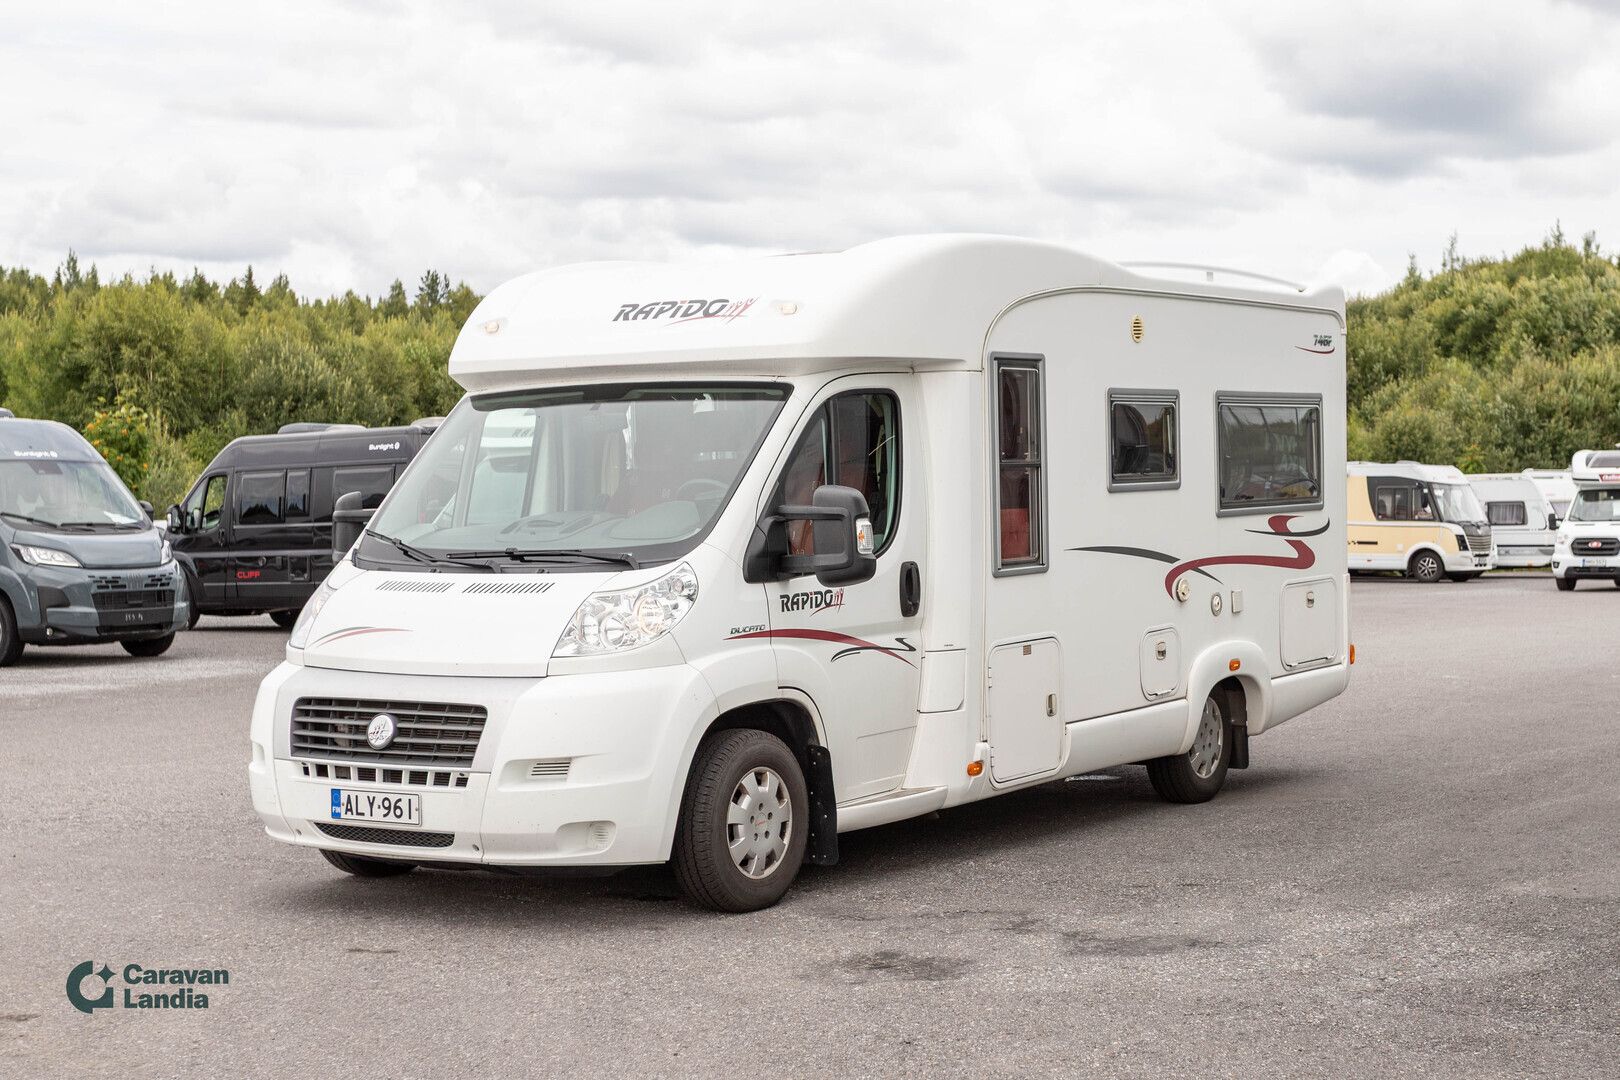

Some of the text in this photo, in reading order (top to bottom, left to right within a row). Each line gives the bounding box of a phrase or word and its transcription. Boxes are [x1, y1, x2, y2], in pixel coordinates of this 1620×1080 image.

[368, 443, 394, 451] Sunlight
[236, 570, 261, 579] CLIFF
[730, 624, 766, 635] DUCATO
[344, 794, 412, 820] ALY-961
